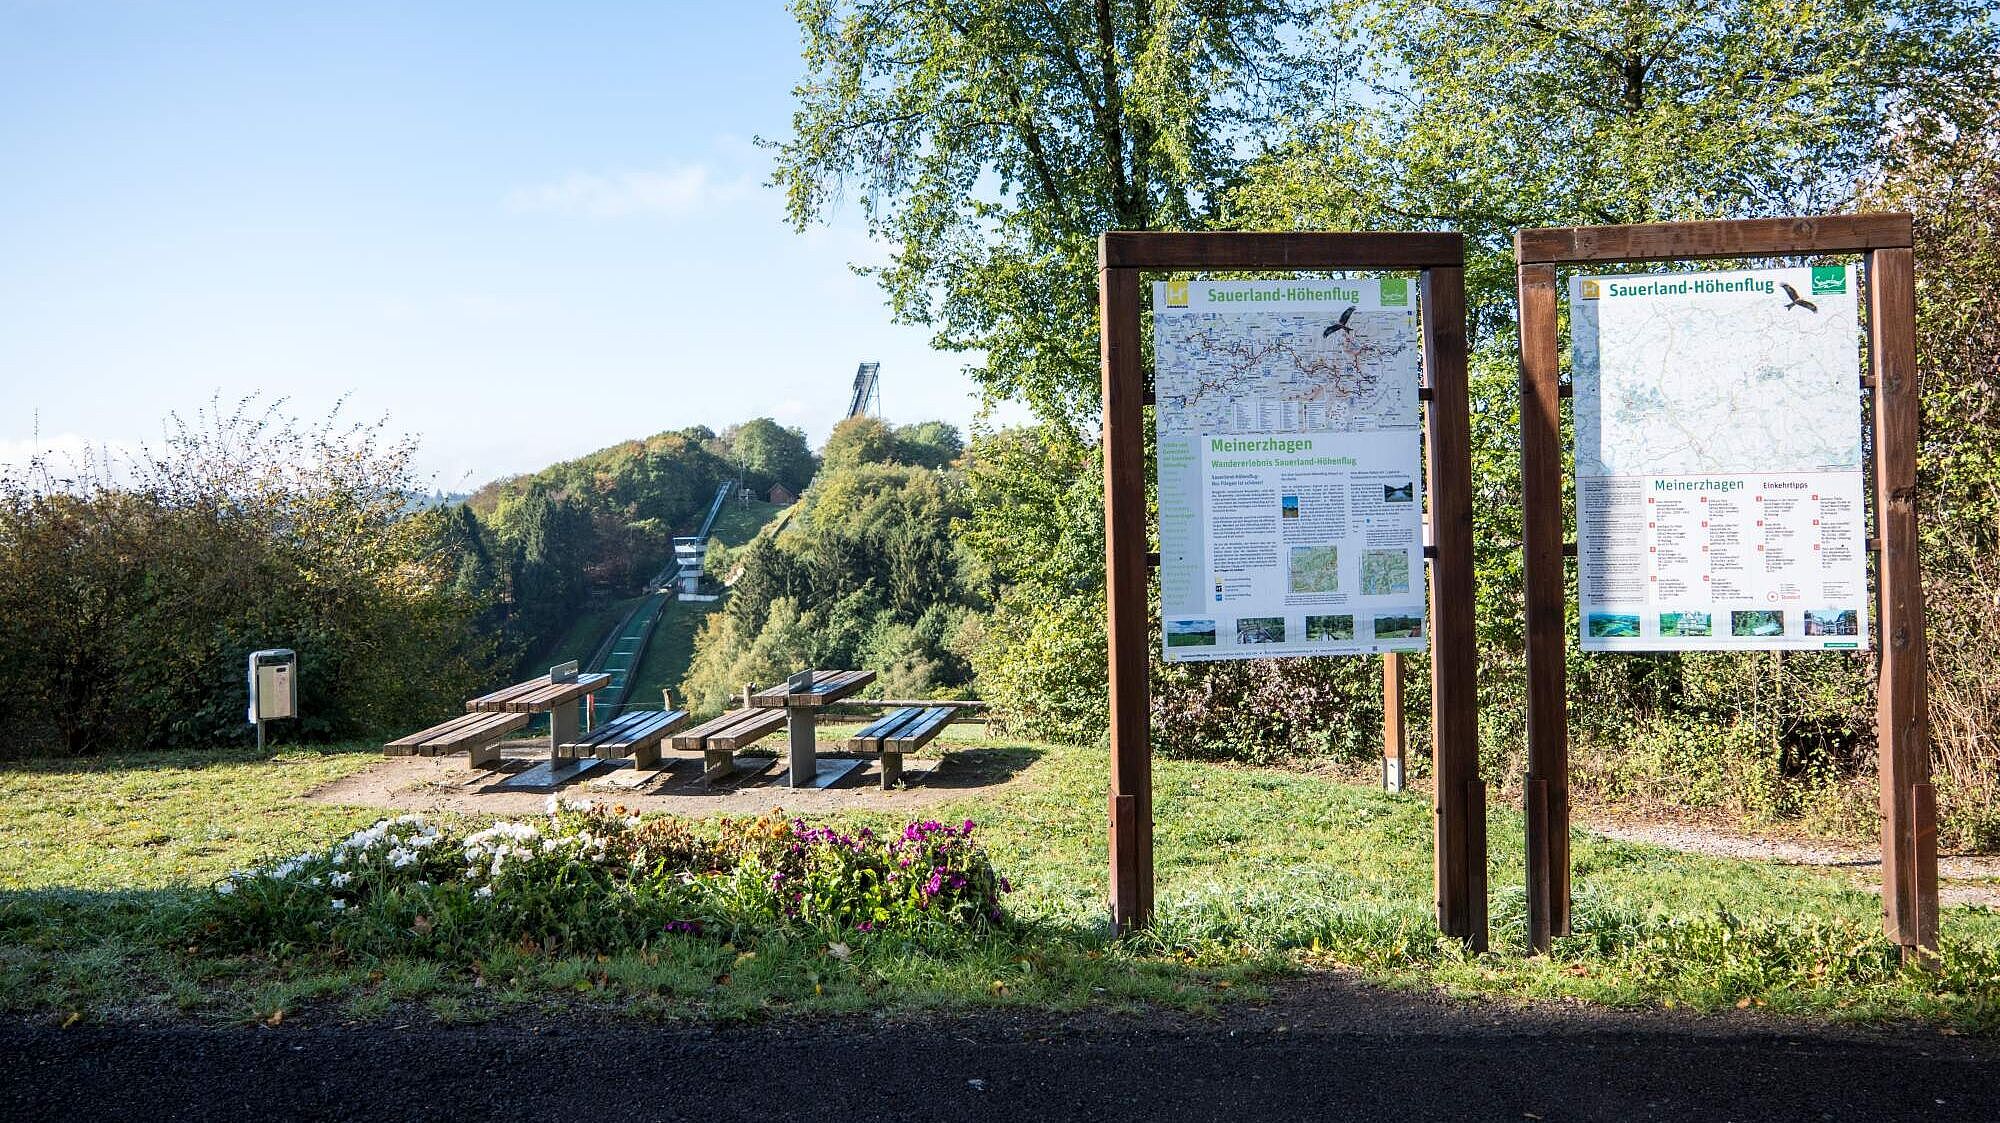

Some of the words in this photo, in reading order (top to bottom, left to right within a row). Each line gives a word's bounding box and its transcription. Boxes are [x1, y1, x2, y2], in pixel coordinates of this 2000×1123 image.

[1609, 277, 1775, 297] Sauerland-Höhenflug
[1208, 286, 1360, 303] Sauerland-Höhenflug
[1211, 438, 1312, 454] Meinerzhagen
[1212, 459, 1273, 468] Wandererlebnis
[1275, 457, 1357, 466] Sauerland-Höhenflug
[1655, 479, 1744, 492] Meinerzhagen
[1763, 482, 1808, 490] Einkehrtipps
